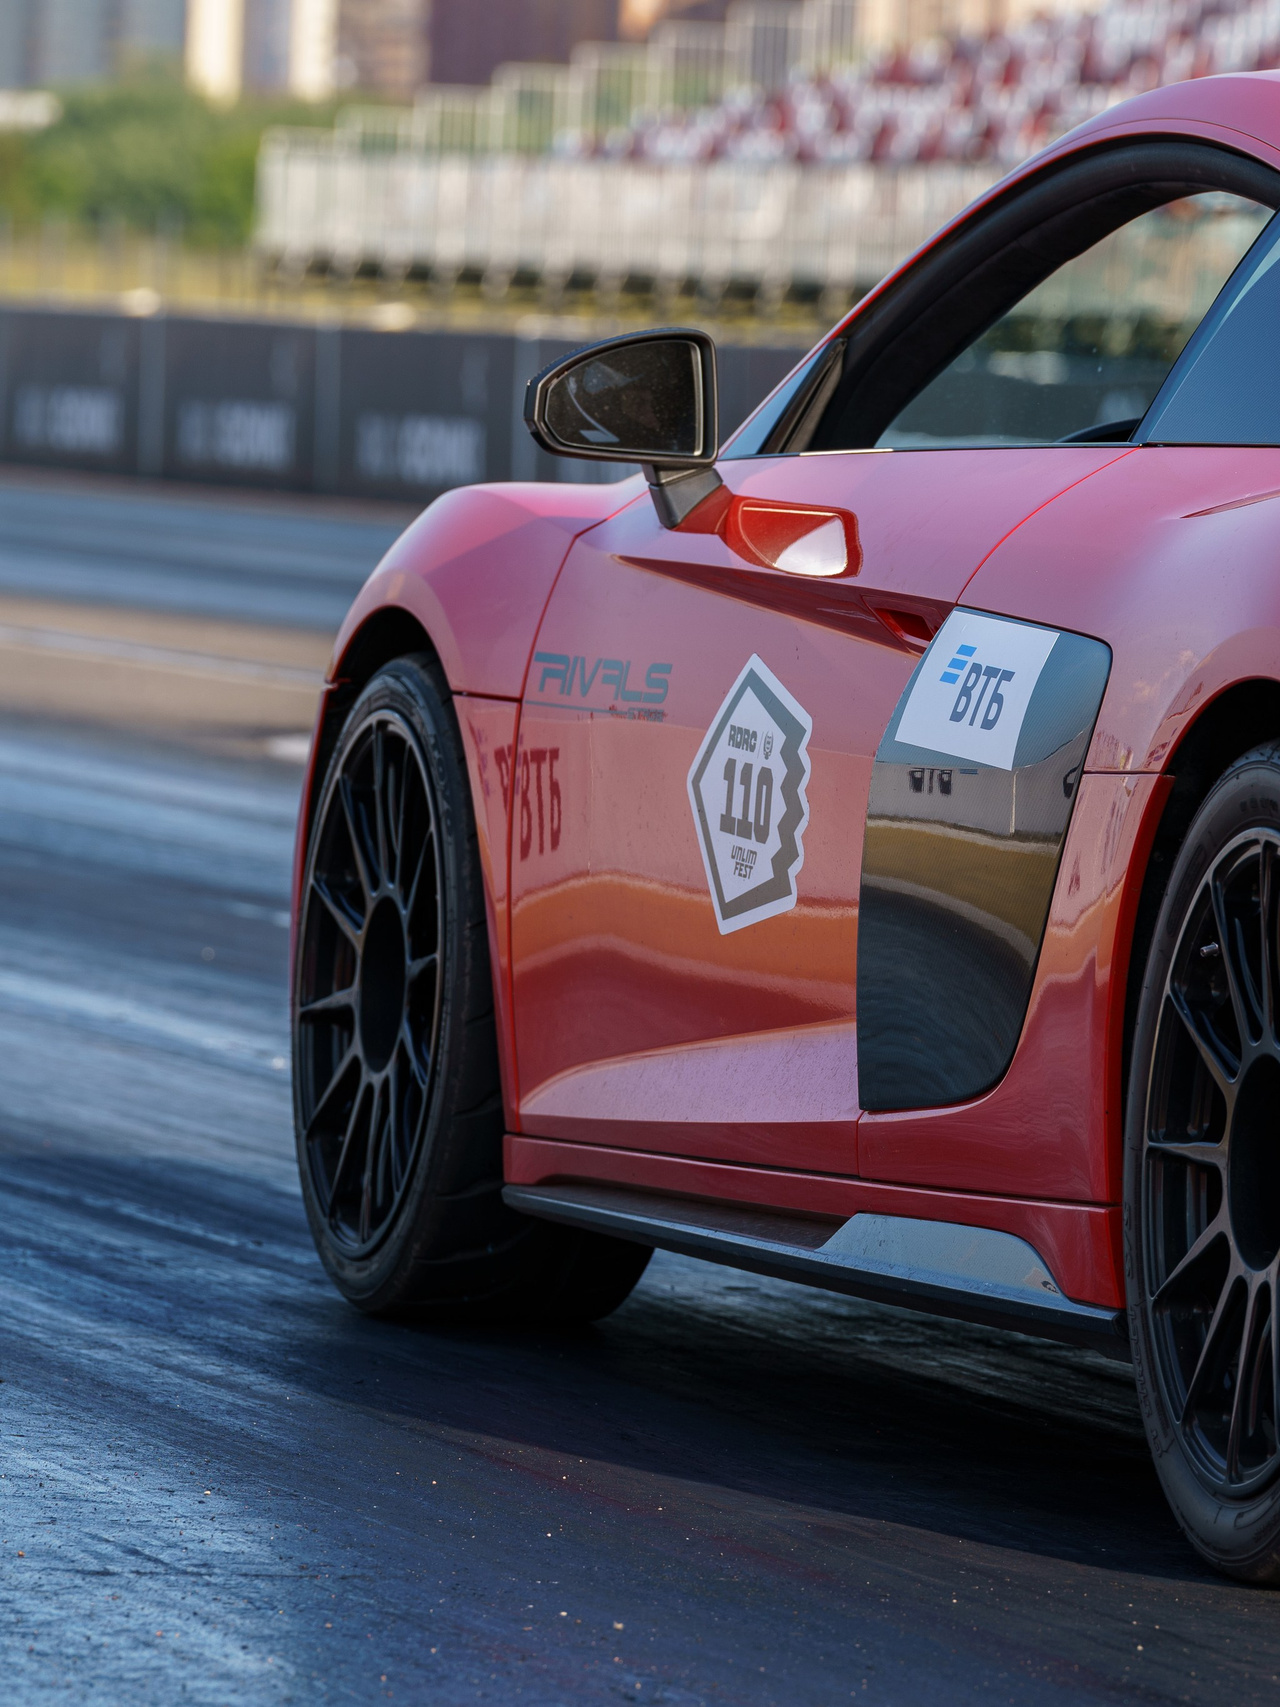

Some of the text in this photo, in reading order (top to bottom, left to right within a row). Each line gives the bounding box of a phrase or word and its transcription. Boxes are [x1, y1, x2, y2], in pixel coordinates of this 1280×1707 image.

[534, 651, 673, 704] RIVALS
[949, 662, 1016, 730] ВТБ
[728, 724, 758, 753] RDRC
[719, 757, 774, 845] 110
[733, 861, 753, 879] FEST
